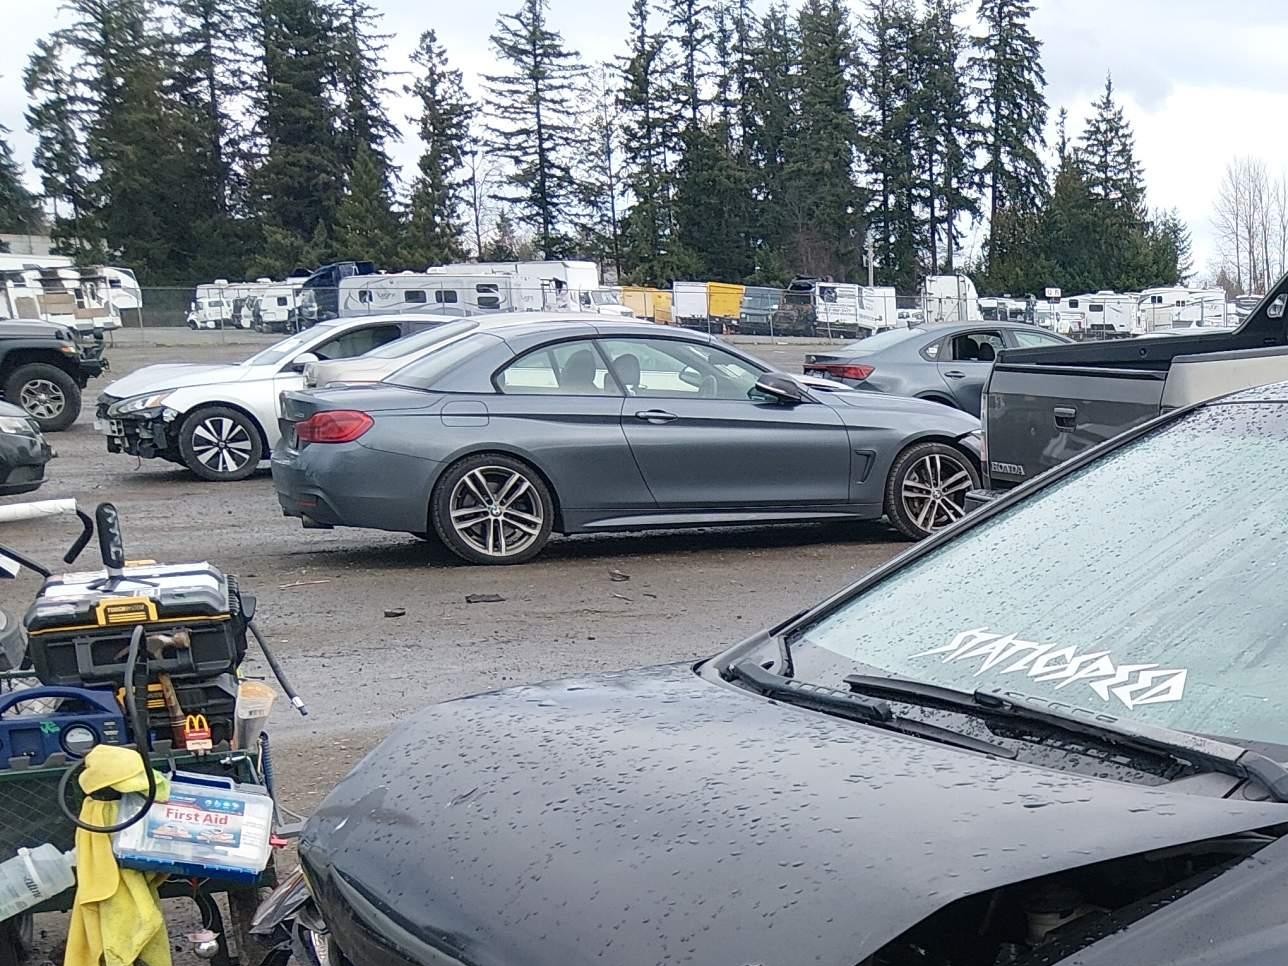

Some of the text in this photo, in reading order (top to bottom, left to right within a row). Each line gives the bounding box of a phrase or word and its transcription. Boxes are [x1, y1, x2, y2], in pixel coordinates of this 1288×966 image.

[991, 461, 1026, 476] HONDA
[166, 807, 200, 822] First
[203, 812, 229, 825] Aid
